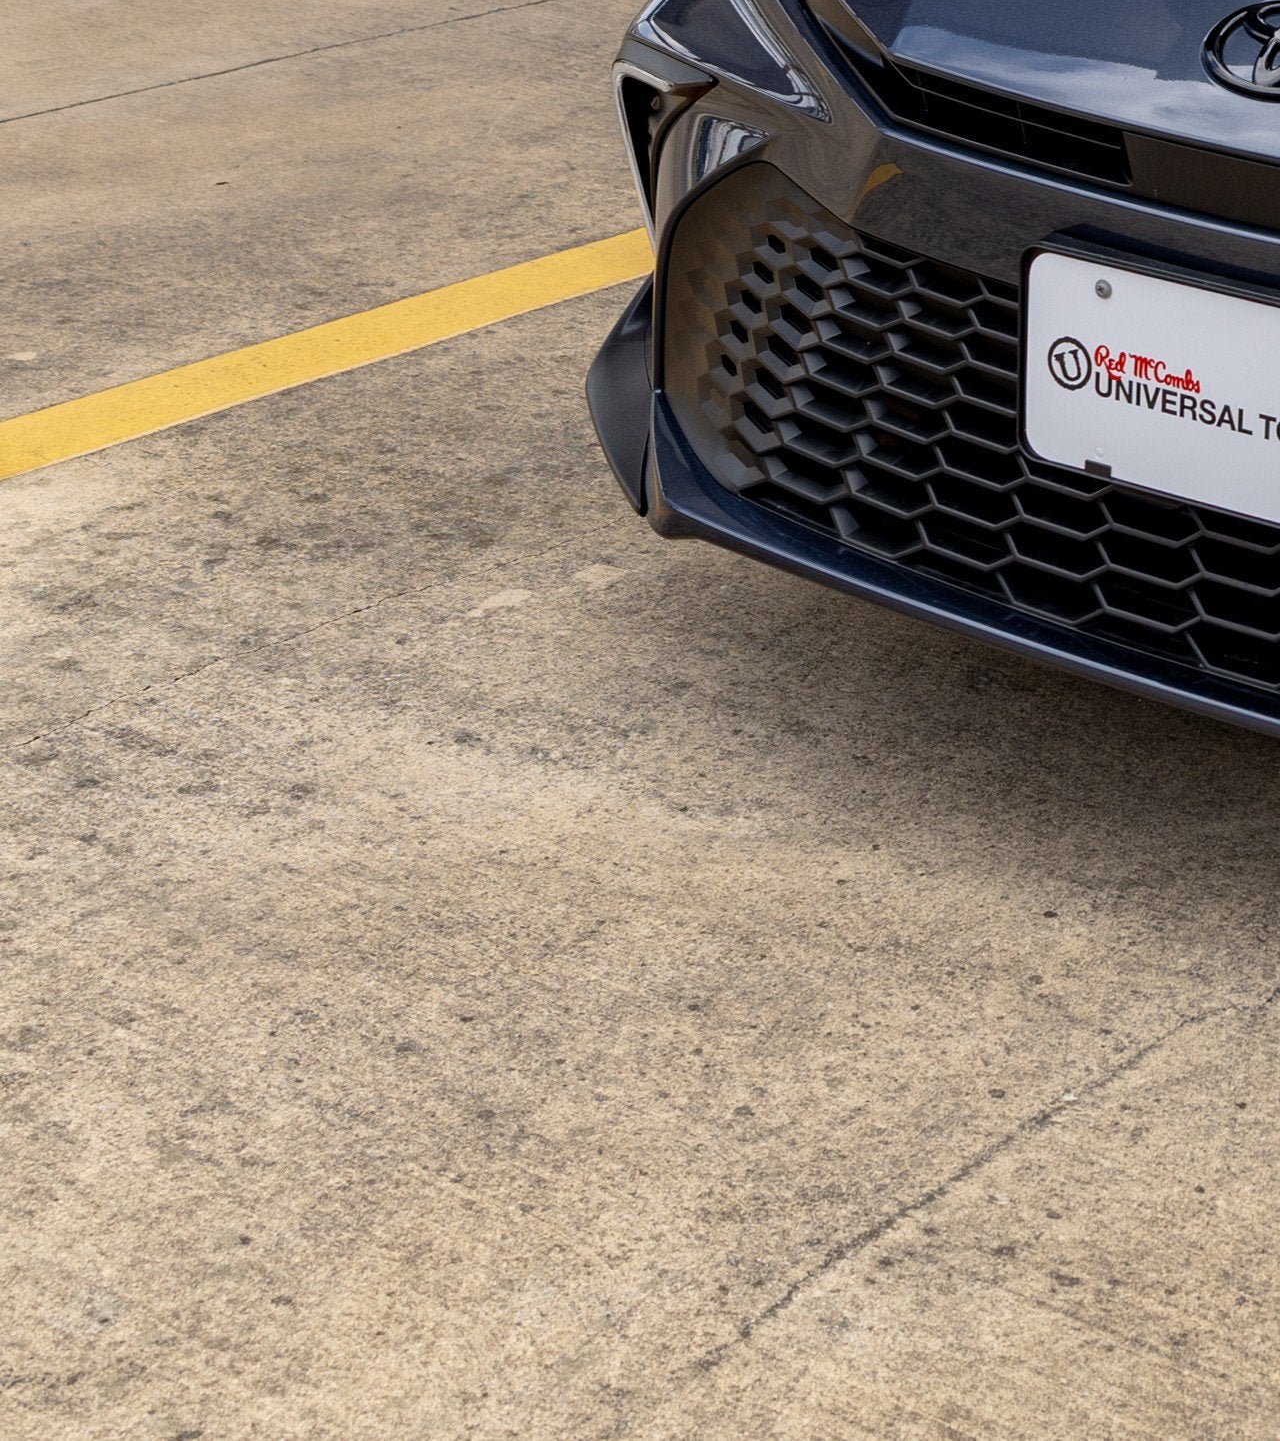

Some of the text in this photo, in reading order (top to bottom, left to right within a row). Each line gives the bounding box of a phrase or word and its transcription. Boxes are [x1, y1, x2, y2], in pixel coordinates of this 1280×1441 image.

[1094, 345, 1201, 394] Red McCombs
[1095, 371, 1253, 436] UNIVERSAL
